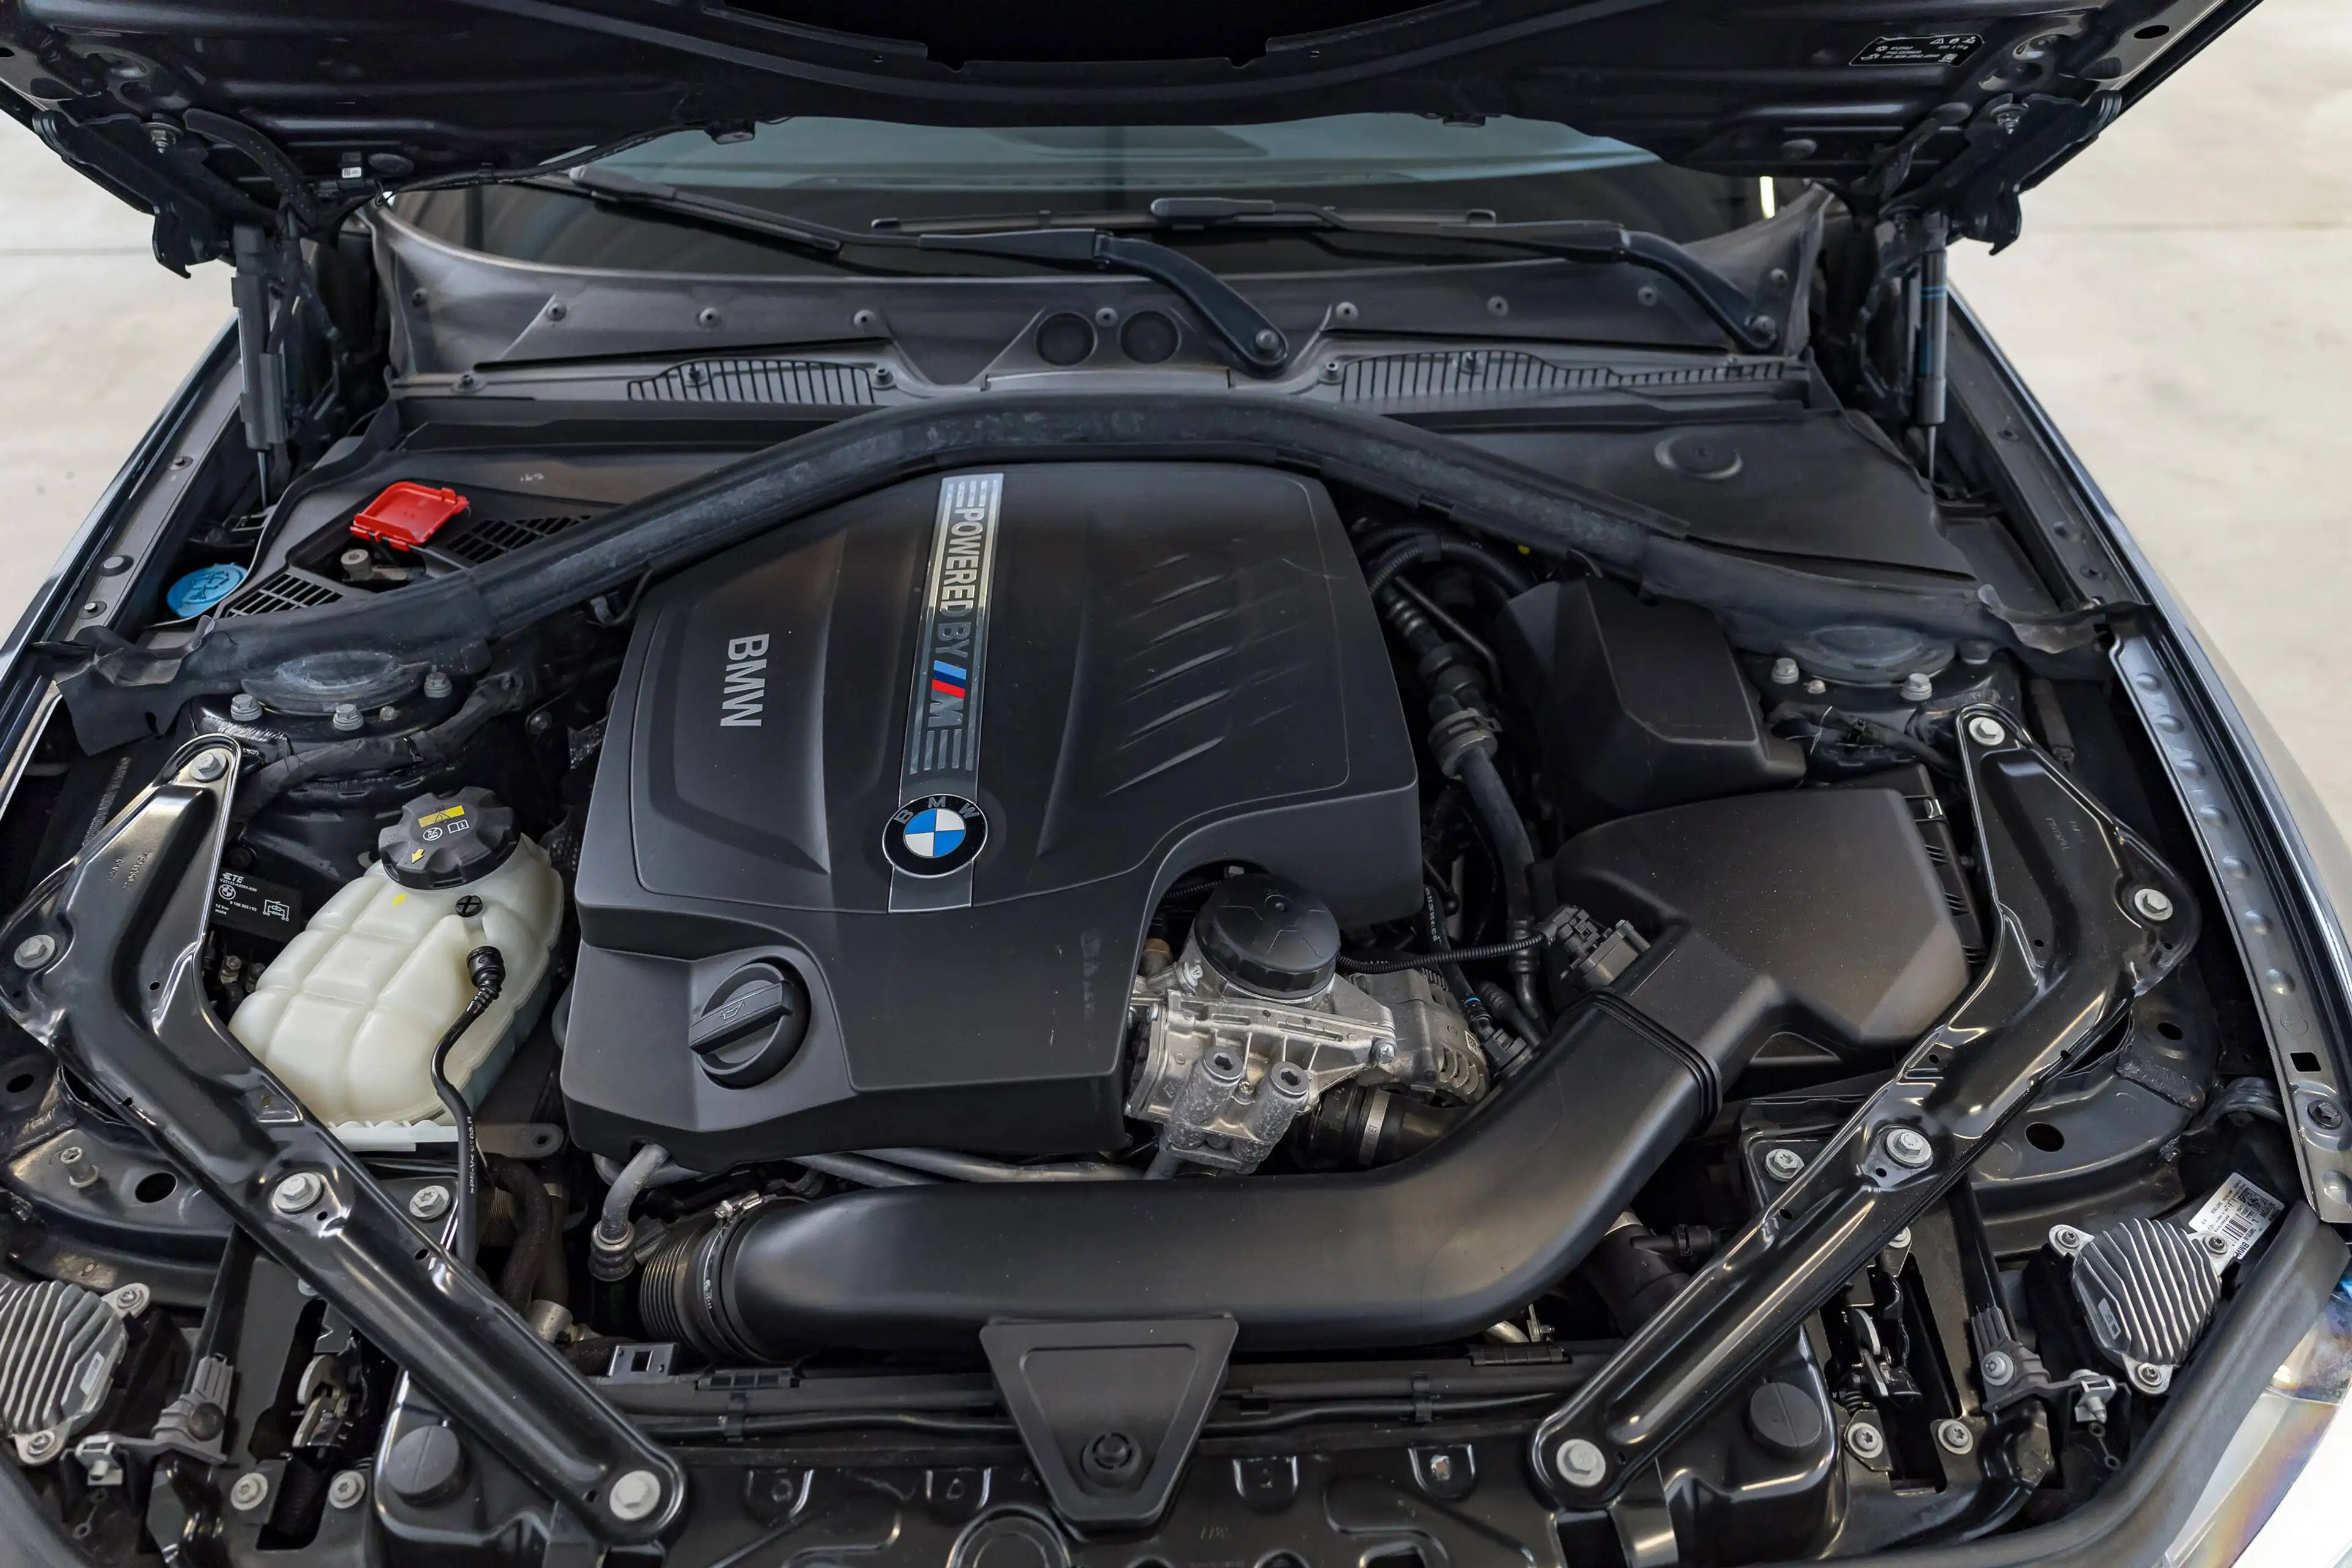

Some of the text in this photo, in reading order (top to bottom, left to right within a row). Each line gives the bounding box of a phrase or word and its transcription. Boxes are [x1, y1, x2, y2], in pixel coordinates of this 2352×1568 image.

[939, 506, 983, 617] POWERED
[935, 621, 971, 660] BY
[720, 633, 770, 728] BMW
[895, 796, 979, 824] BMW
[2234, 1242, 2250, 1257] BMW
